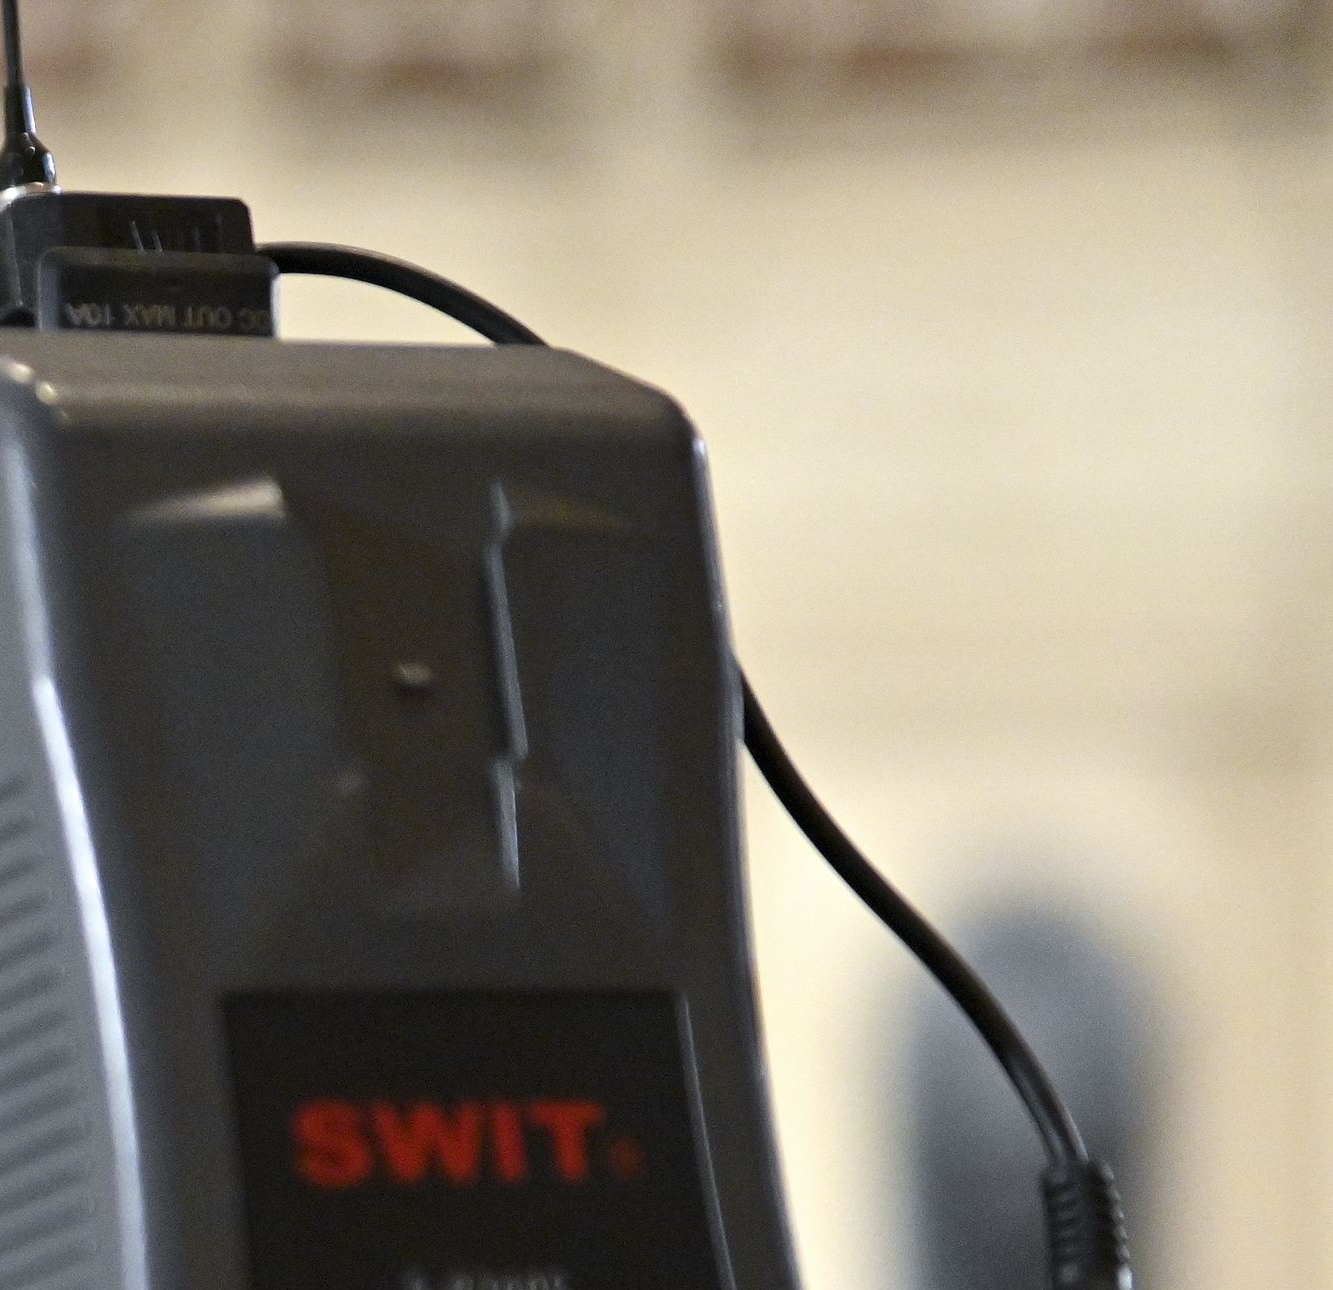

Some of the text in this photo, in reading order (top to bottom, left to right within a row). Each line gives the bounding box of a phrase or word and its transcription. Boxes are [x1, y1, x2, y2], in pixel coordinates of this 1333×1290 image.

[123, 303, 176, 327] MAX
[186, 305, 232, 329] OUT
[293, 1098, 603, 1187] SWIT
